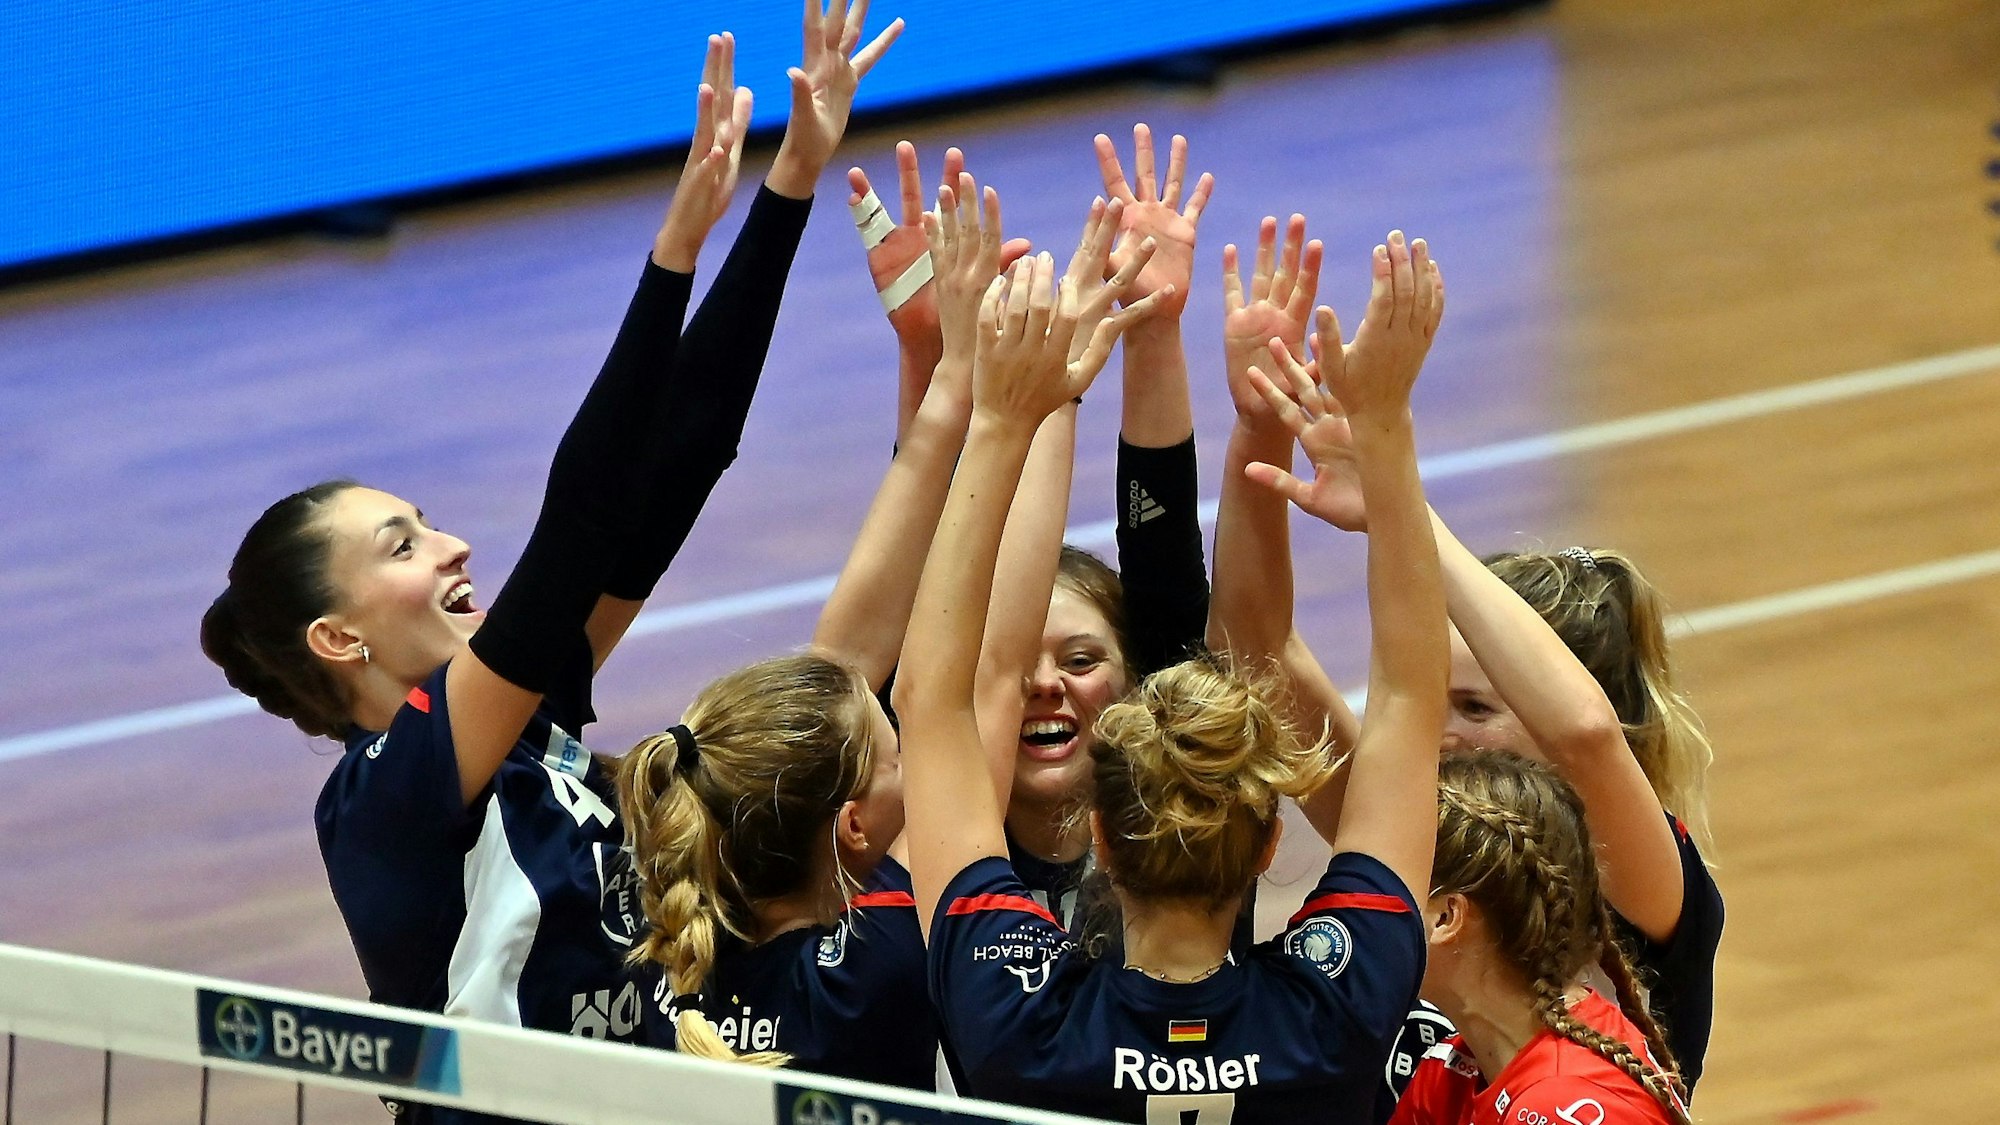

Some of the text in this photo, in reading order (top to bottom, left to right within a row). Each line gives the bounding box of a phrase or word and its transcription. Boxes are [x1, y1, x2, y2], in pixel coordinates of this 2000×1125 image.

[1129, 480, 1141, 528] adidas
[531, 757, 616, 829] 4
[974, 944, 1034, 960] BEACH
[272, 1009, 391, 1074] Bayer
[1114, 1047, 1260, 1092] Rößler
[1517, 1107, 1557, 1125] COR
